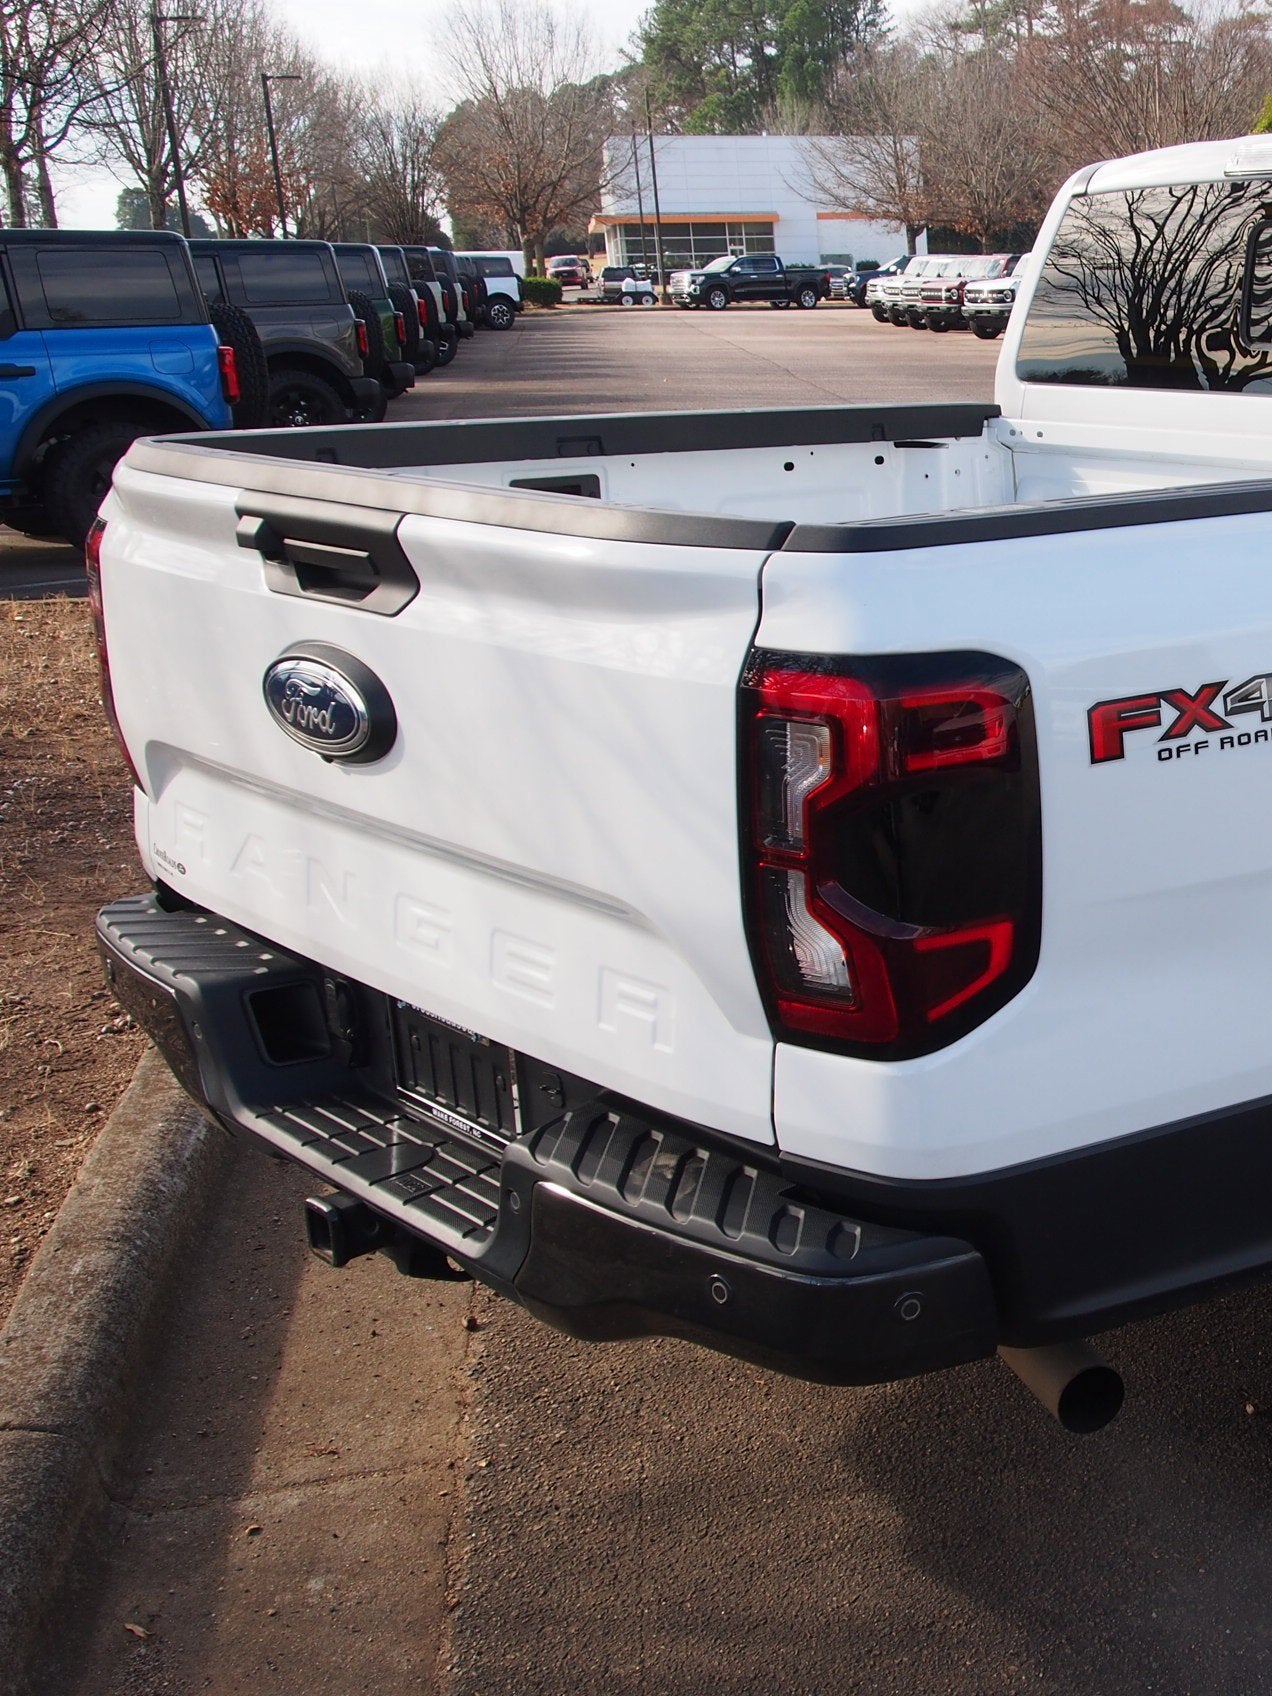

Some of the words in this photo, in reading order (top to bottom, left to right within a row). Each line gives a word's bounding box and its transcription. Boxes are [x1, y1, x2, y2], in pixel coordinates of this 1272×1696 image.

[281, 678, 336, 735] Ford
[1157, 740, 1210, 762] OFF
[172, 799, 677, 1055] RANGER
